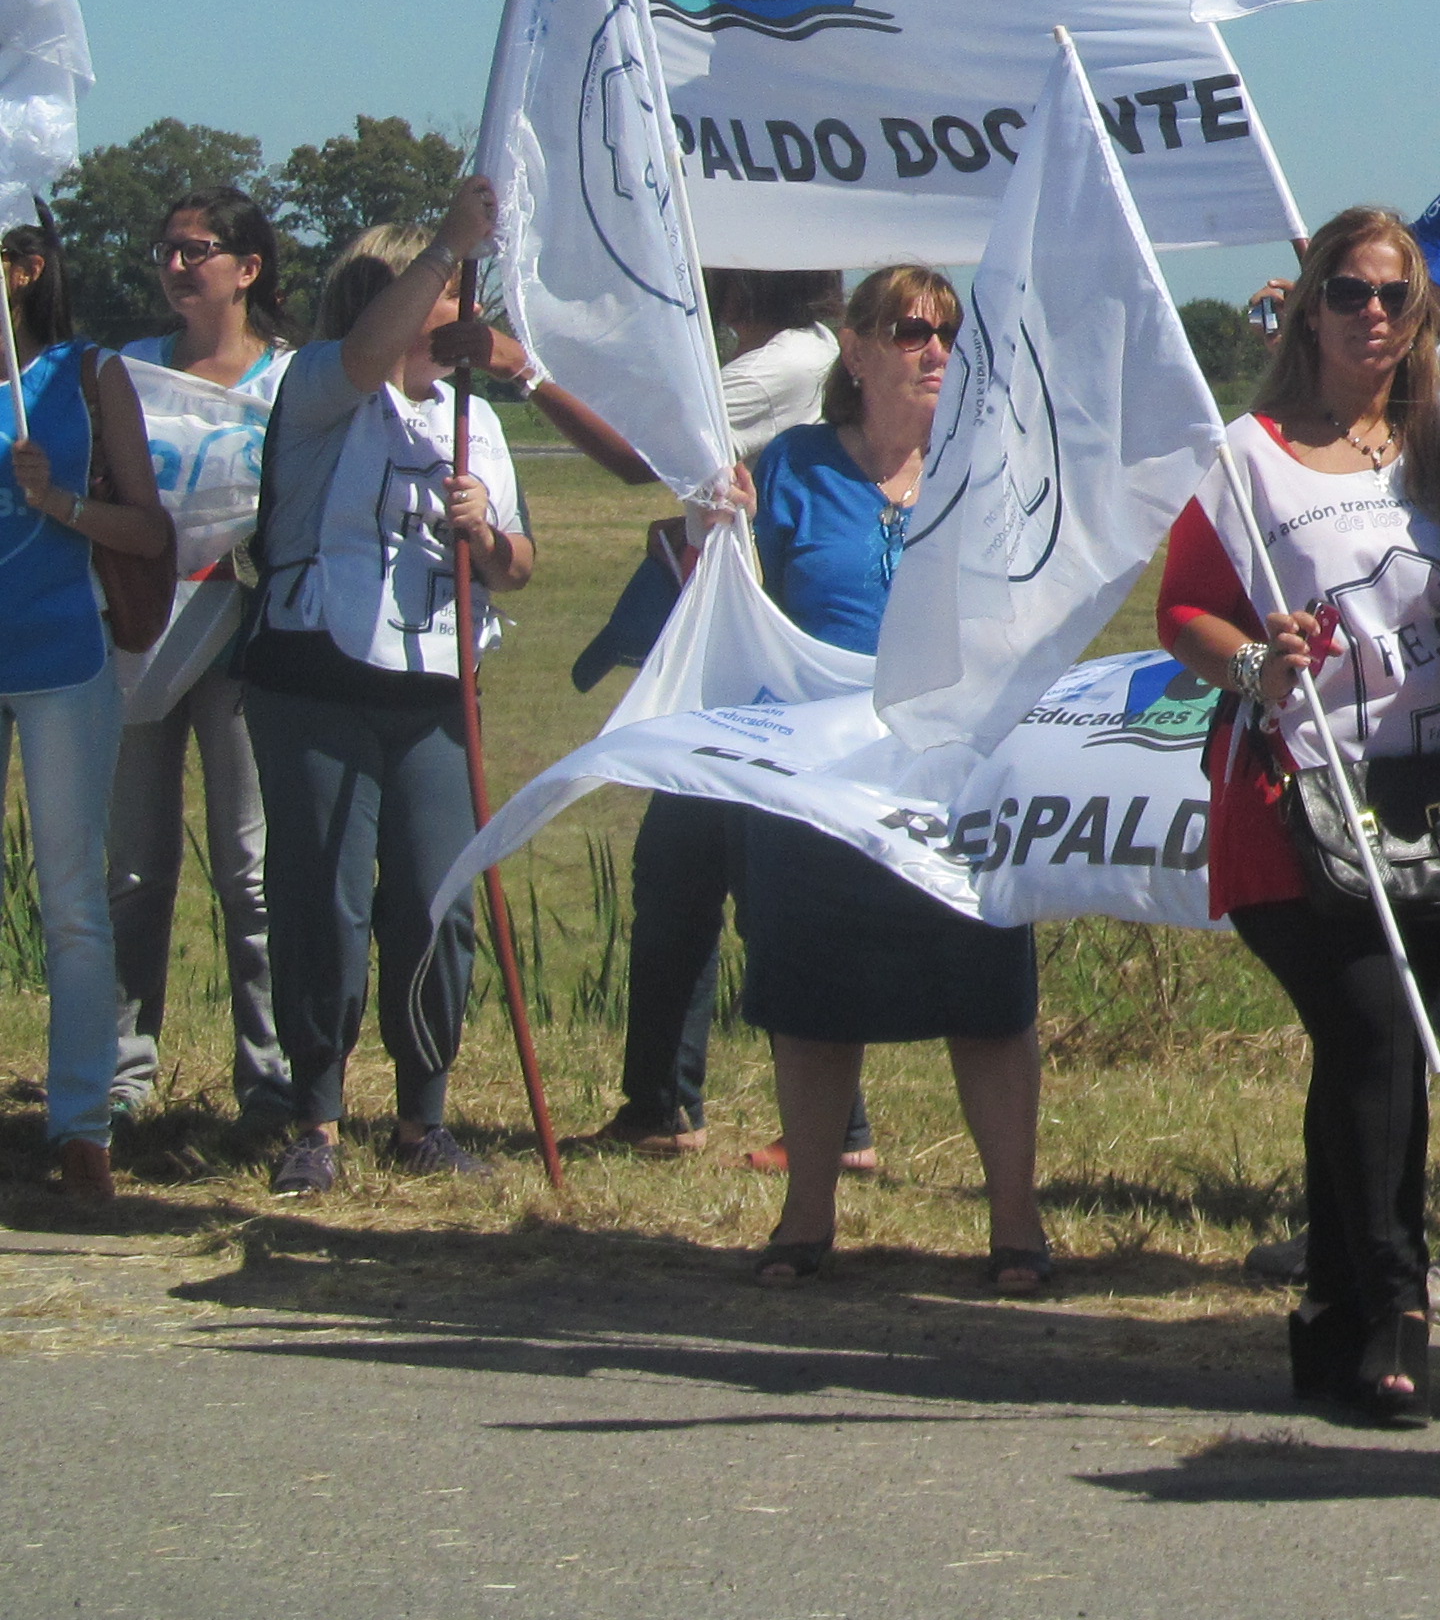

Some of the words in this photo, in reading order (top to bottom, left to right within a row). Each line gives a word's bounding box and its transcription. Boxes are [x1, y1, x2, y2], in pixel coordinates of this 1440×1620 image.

[880, 73, 1250, 179] DOCNTE
[1279, 504, 1337, 534] acción
[1334, 513, 1364, 534] de
[1371, 510, 1403, 529] los
